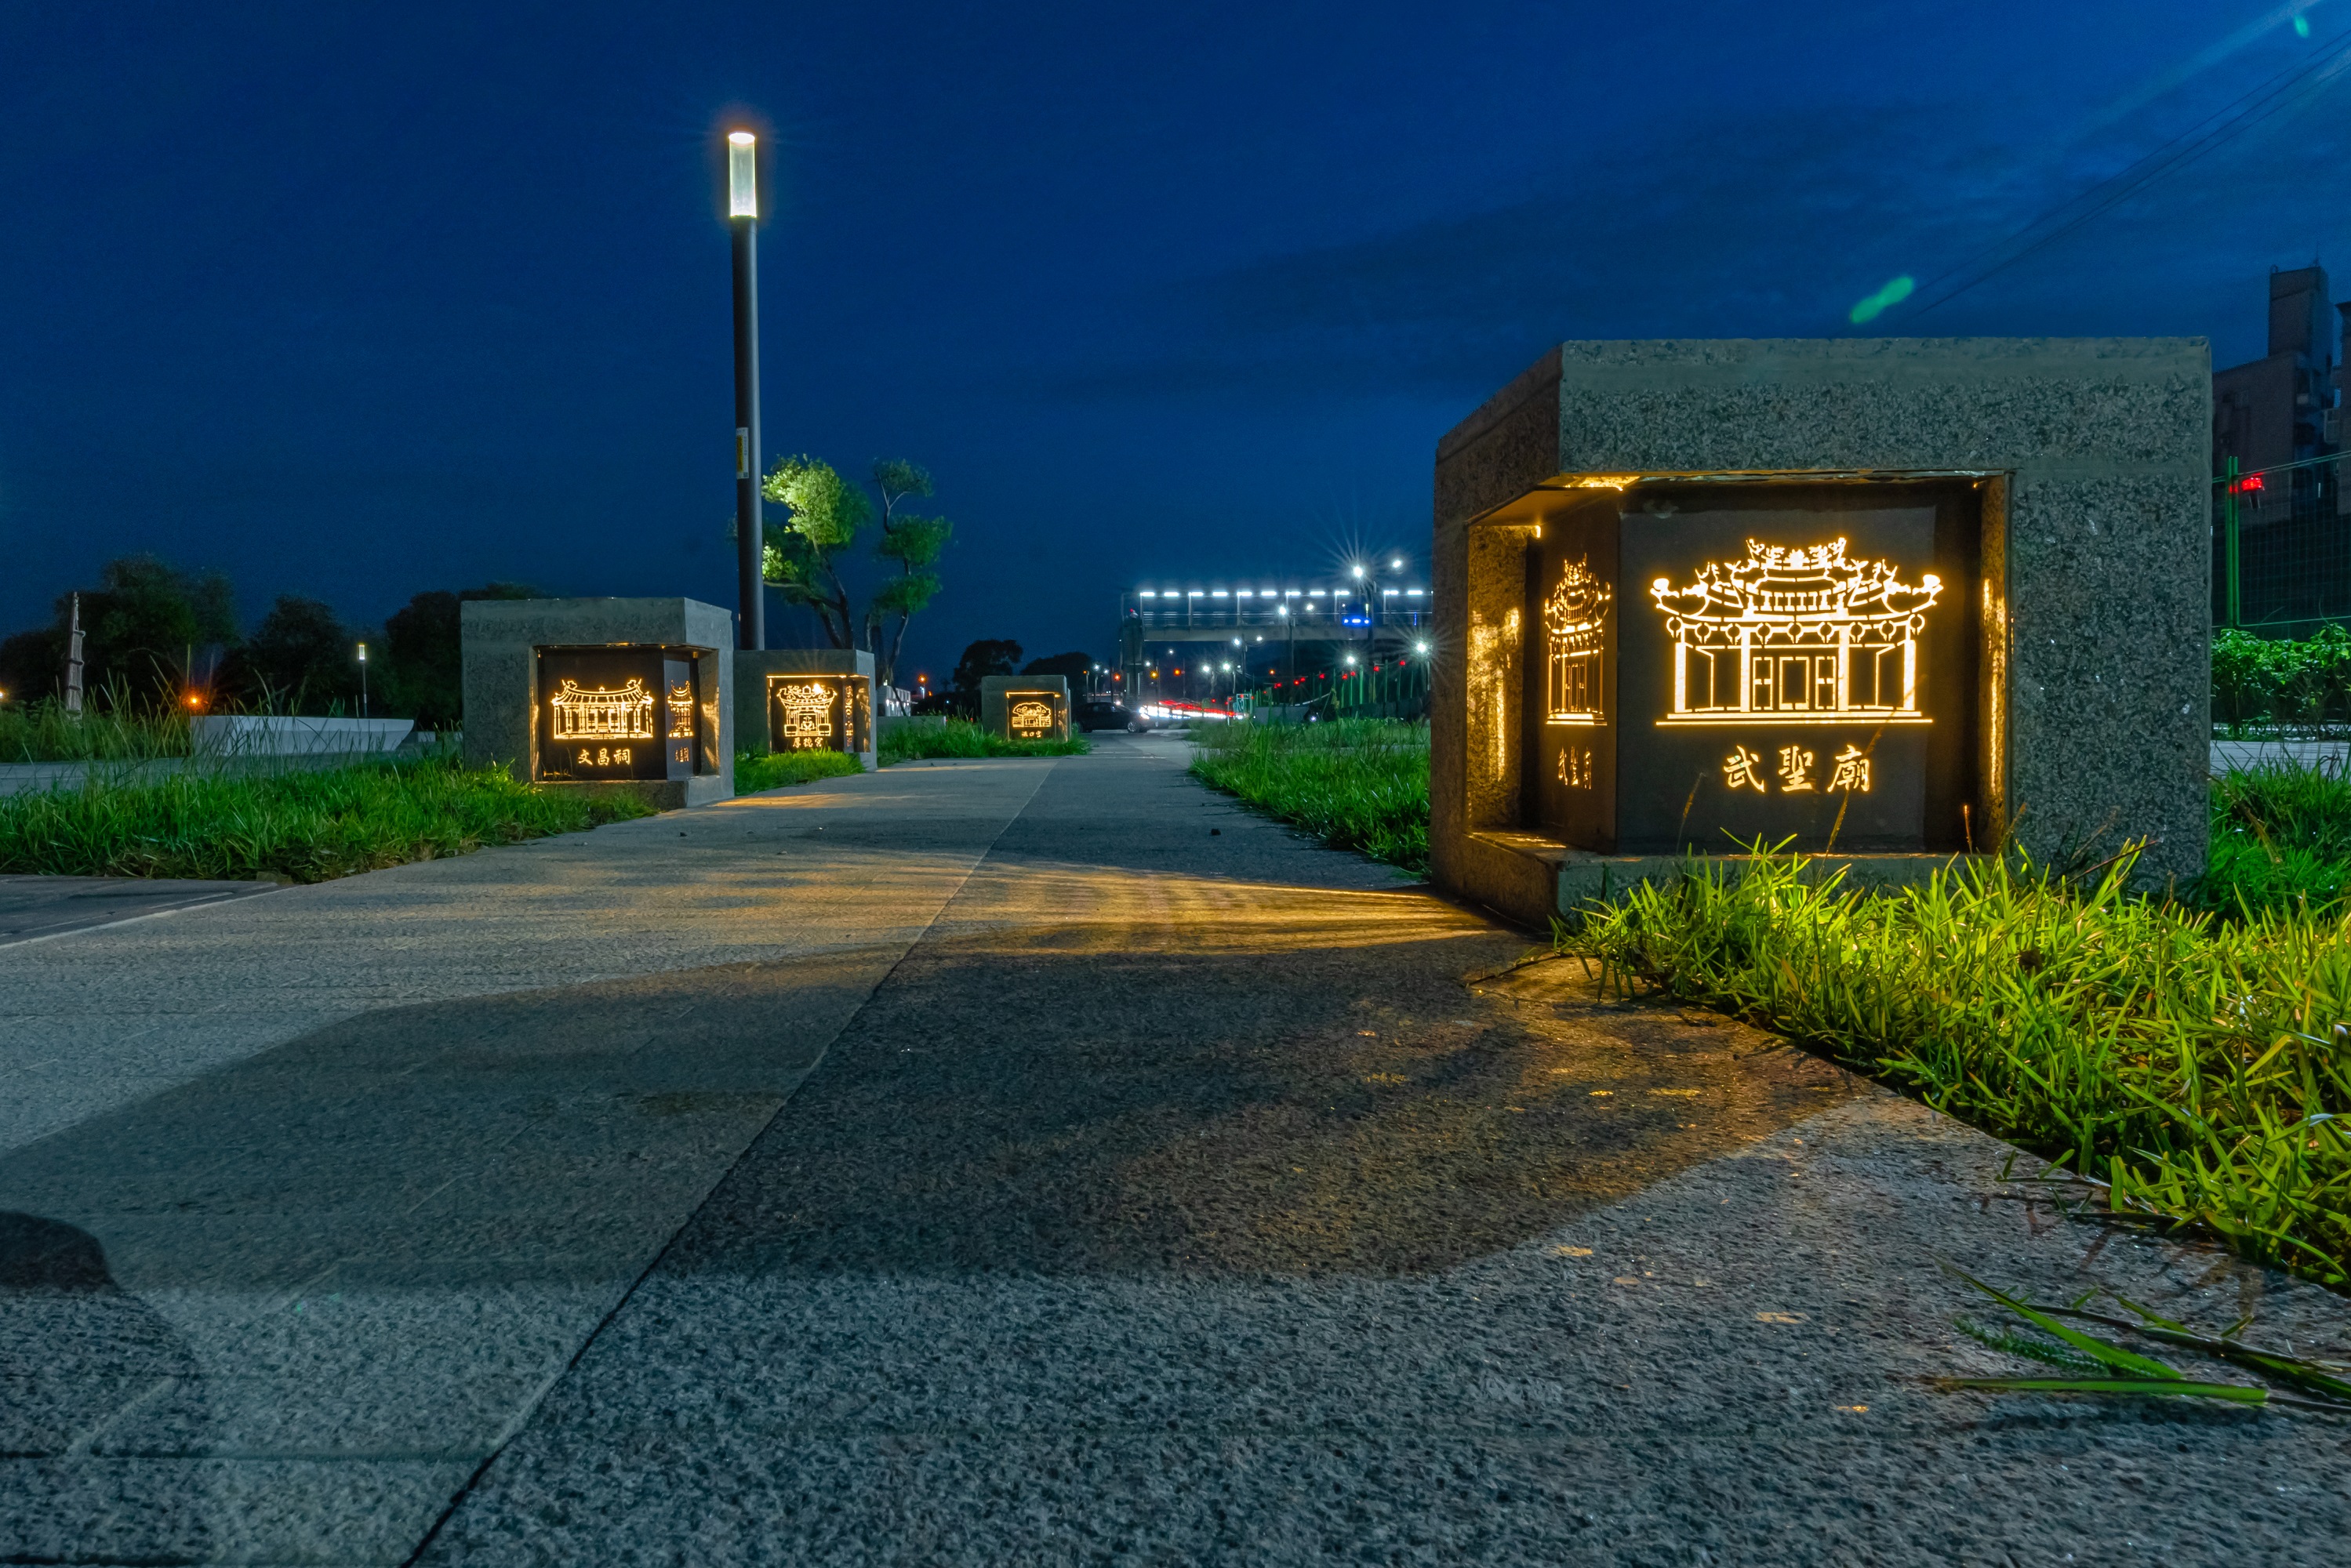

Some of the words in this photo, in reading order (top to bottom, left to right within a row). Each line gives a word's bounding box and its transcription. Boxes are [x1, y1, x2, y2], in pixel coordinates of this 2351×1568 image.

[578, 748, 630, 766] 文昌祠
[1723, 745, 1871, 793] 武聖廟
